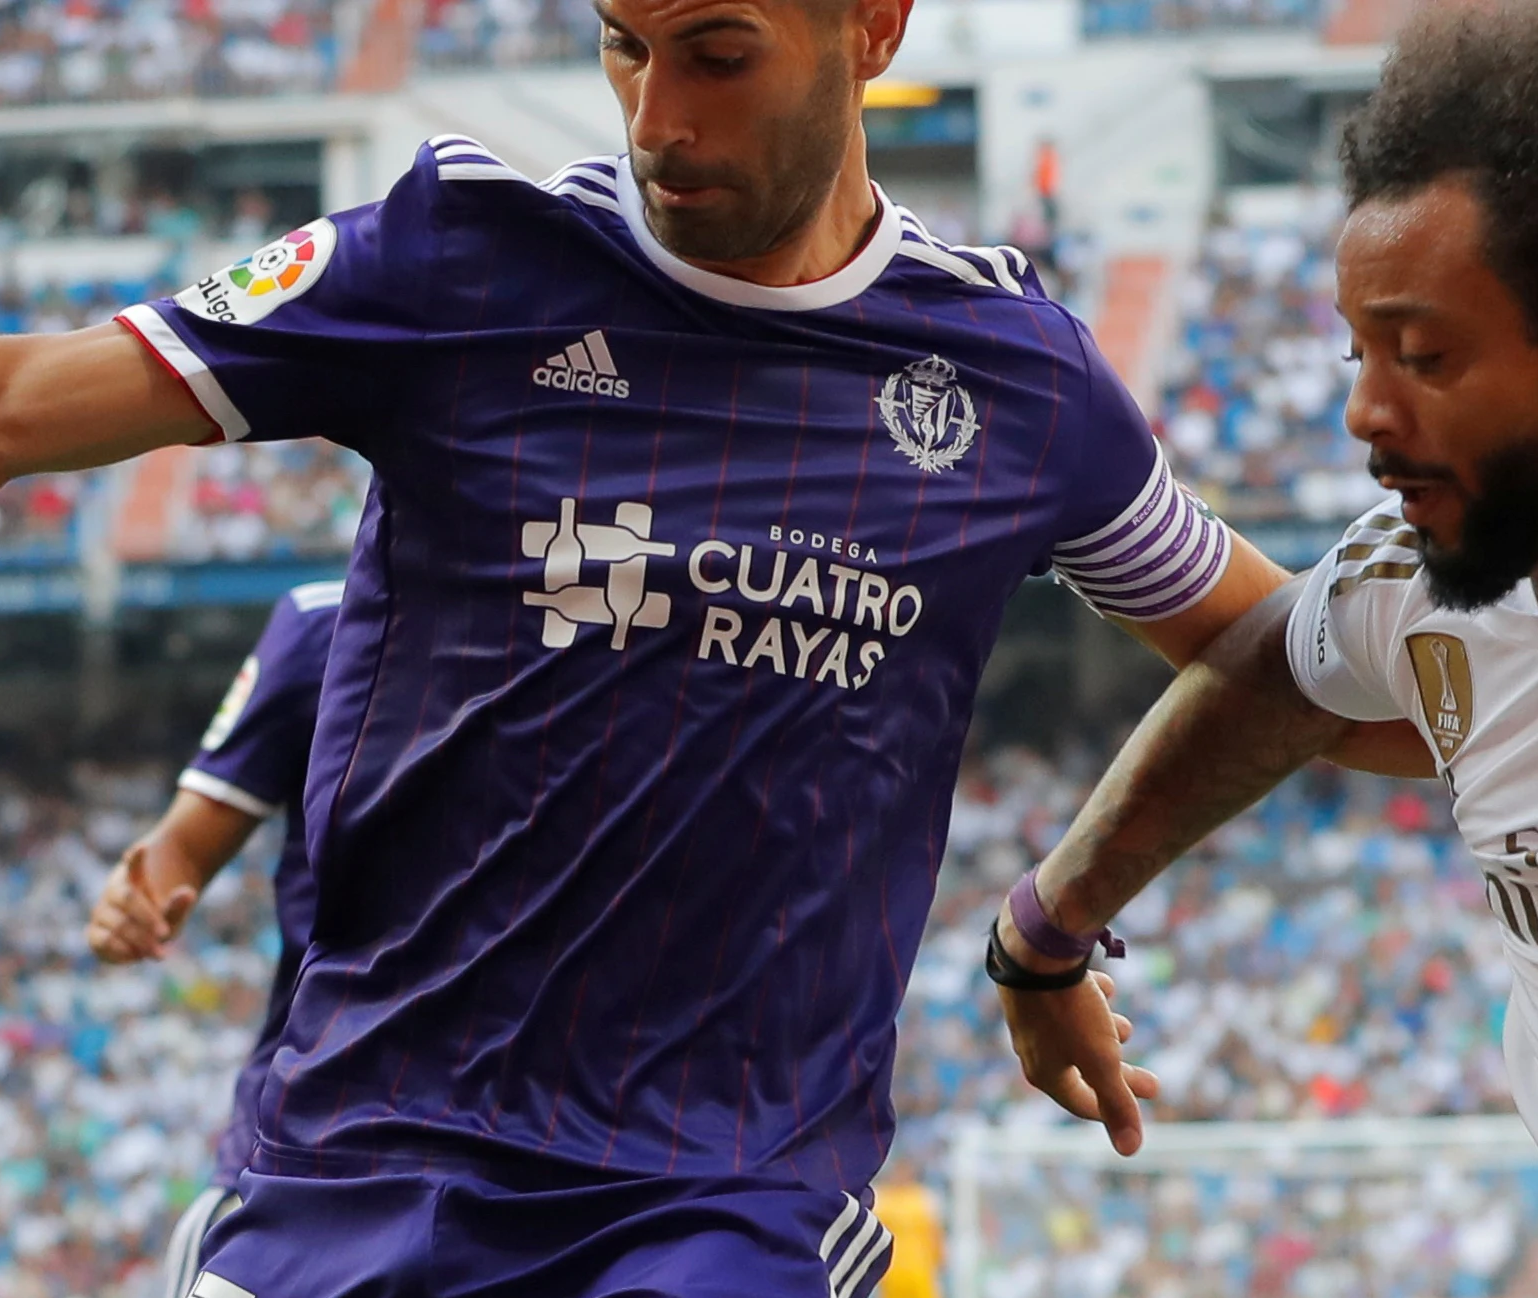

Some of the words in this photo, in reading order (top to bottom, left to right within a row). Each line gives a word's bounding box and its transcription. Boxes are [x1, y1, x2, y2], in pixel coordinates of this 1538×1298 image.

[532, 366, 630, 399] adidas
[769, 525, 878, 564] BODEGA
[688, 540, 923, 637] CUATRO
[697, 605, 886, 691] RAYAS
